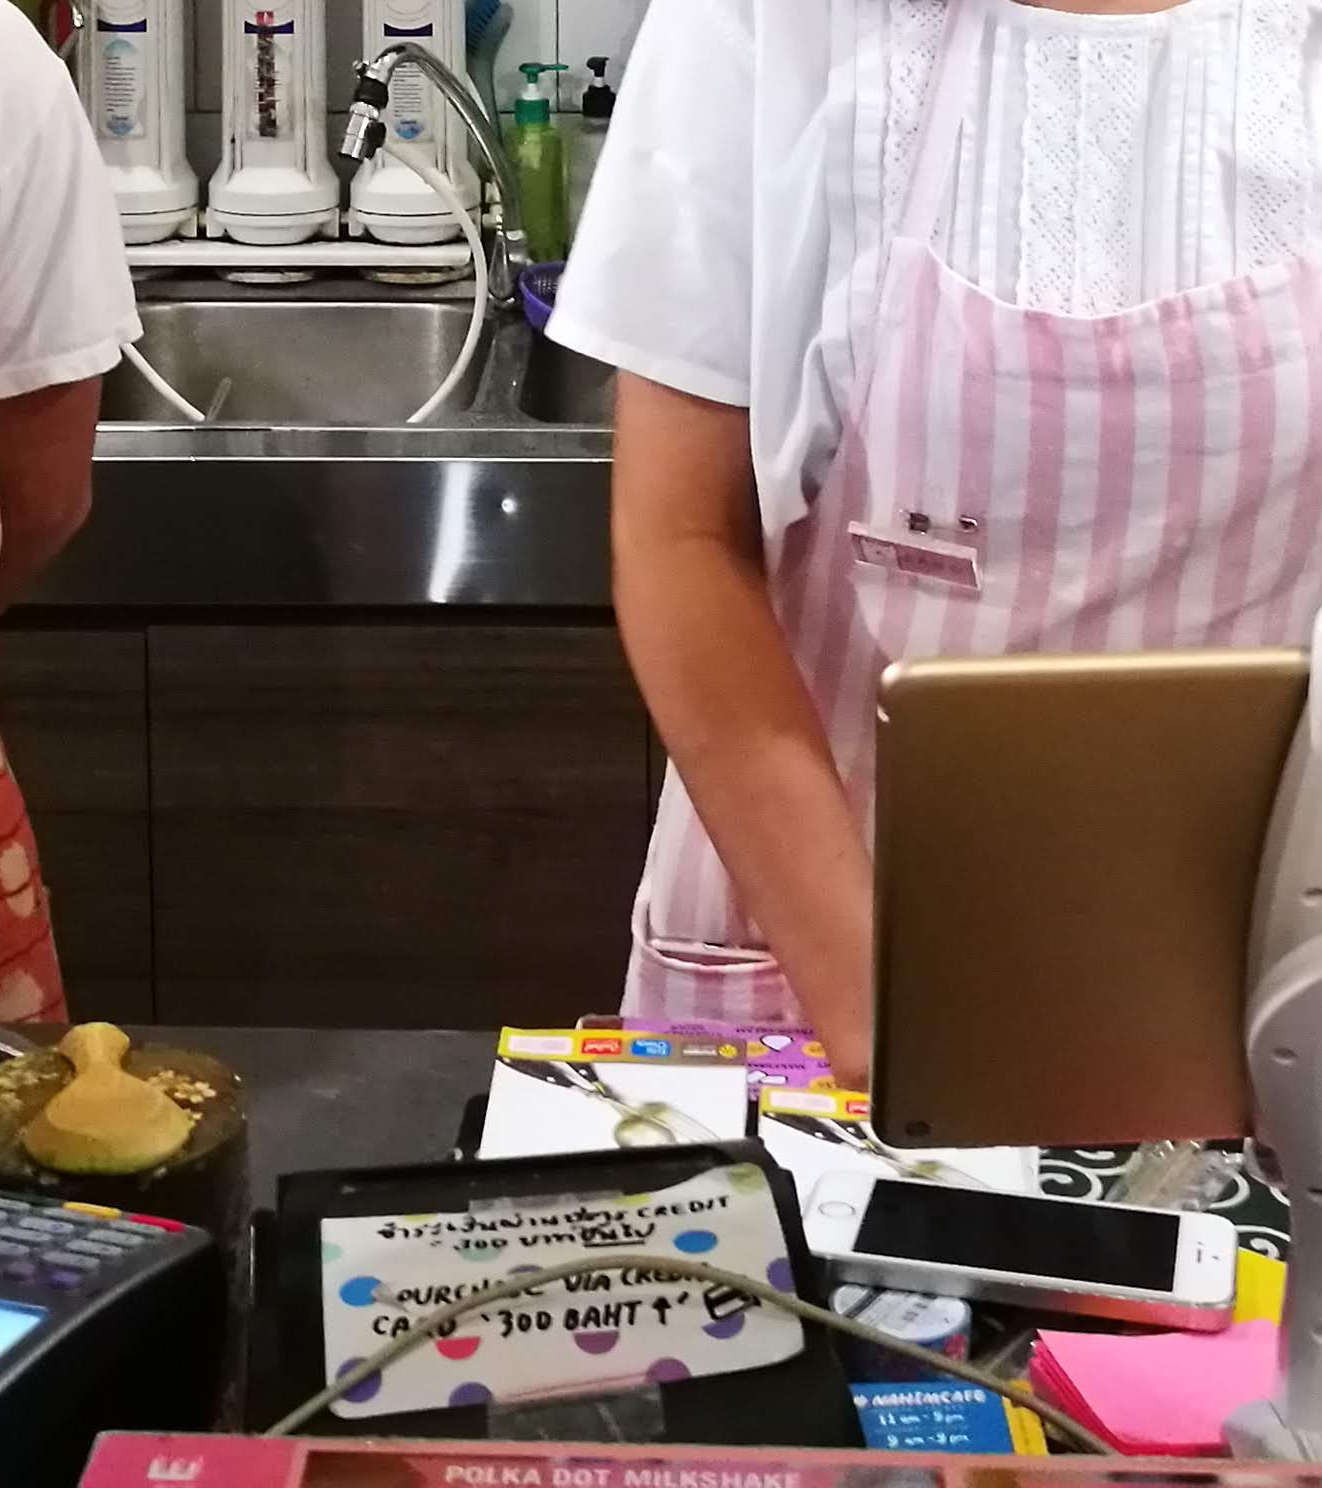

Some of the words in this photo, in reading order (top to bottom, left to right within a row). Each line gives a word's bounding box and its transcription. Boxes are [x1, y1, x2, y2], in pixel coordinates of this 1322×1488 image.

[372, 1315, 457, 1338] CAD
[563, 1300, 643, 1331] BAHT
[445, 1464, 542, 1485] POLKA
[552, 1467, 611, 1488] DOT
